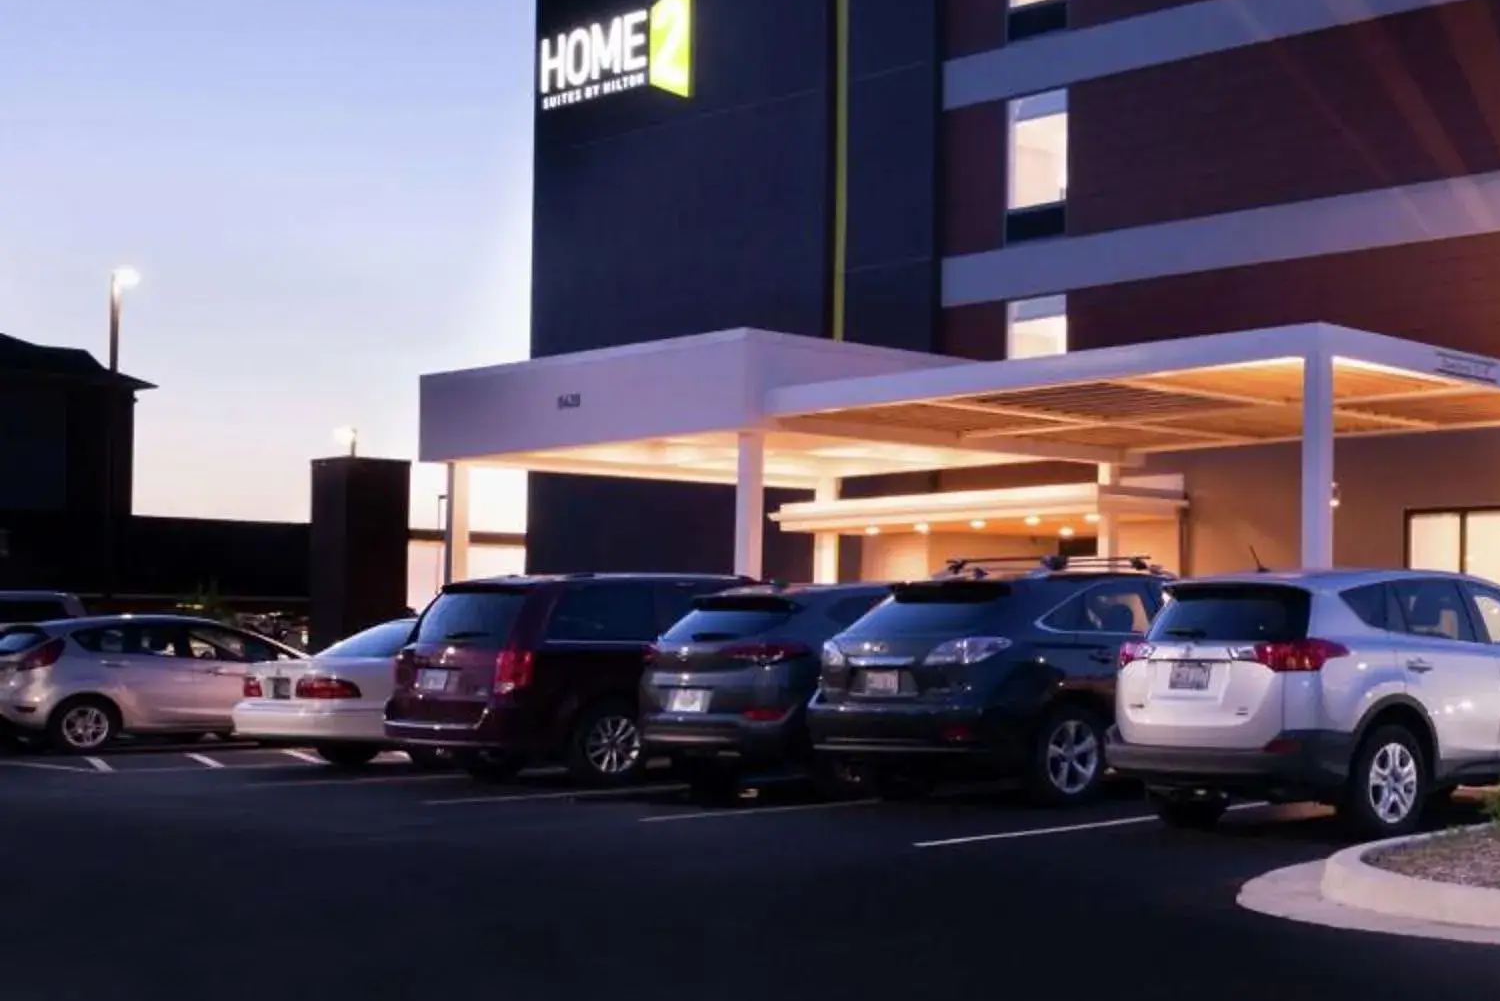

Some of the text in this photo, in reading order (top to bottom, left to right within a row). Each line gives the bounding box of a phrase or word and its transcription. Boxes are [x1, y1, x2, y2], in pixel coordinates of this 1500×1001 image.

[540, 9, 648, 94] HOME
[542, 72, 645, 110] SUITES BY HILTON
